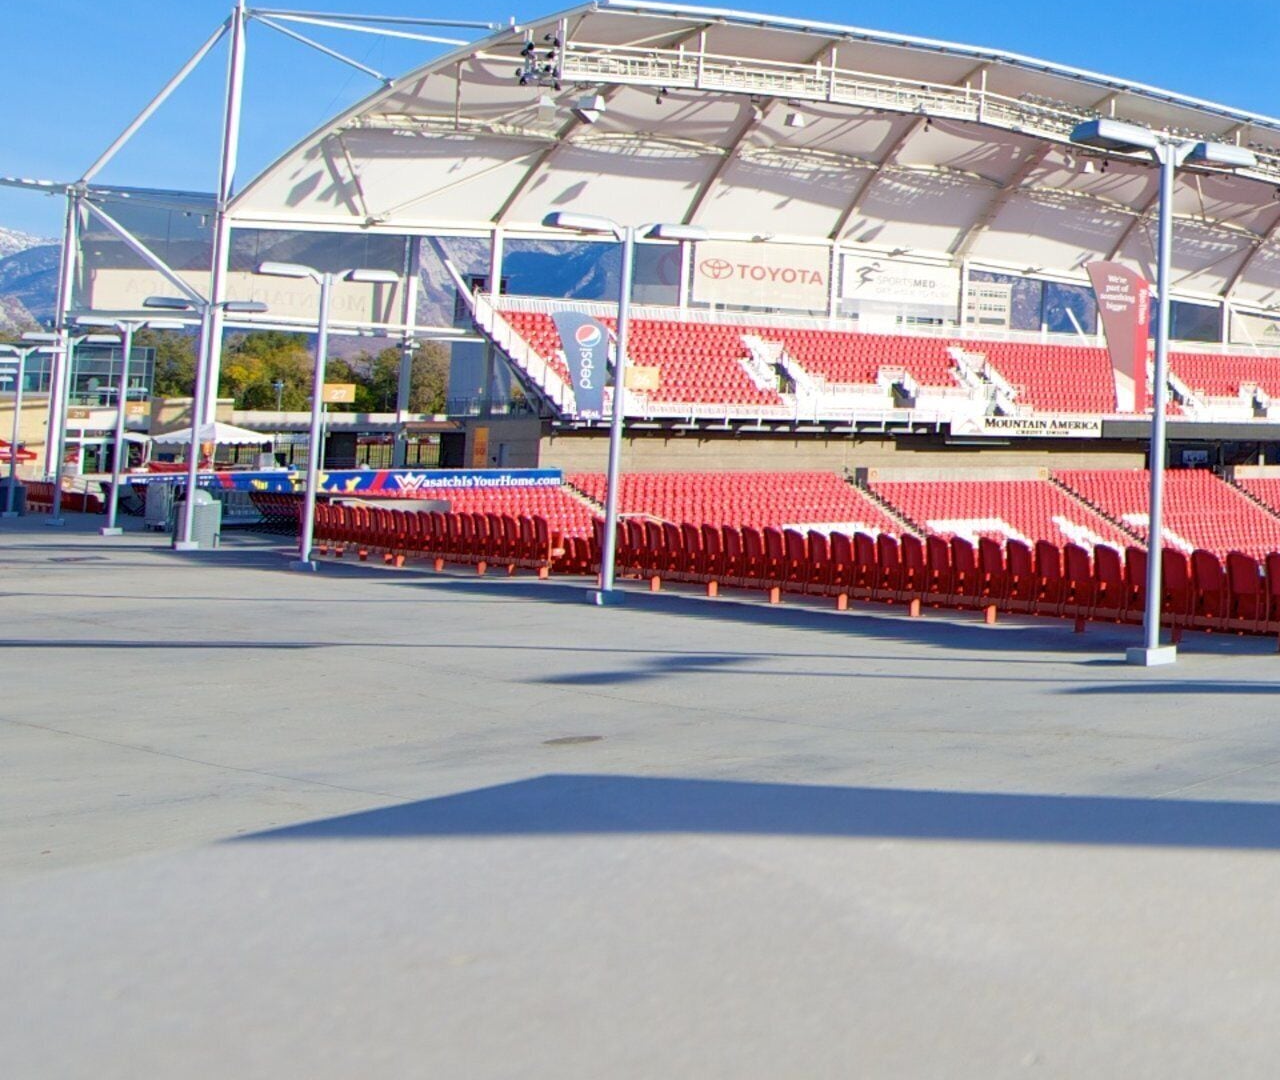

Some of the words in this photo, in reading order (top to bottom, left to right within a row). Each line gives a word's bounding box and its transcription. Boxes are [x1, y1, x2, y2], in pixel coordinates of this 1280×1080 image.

[737, 264, 824, 286] TOYOTA
[580, 347, 594, 389] pepsi
[332, 389, 347, 400] 27
[985, 418, 1047, 429] MOUNTAIN
[1050, 419, 1099, 430] AMERICA
[394, 472, 561, 491] WasatchIsYourHome.com
